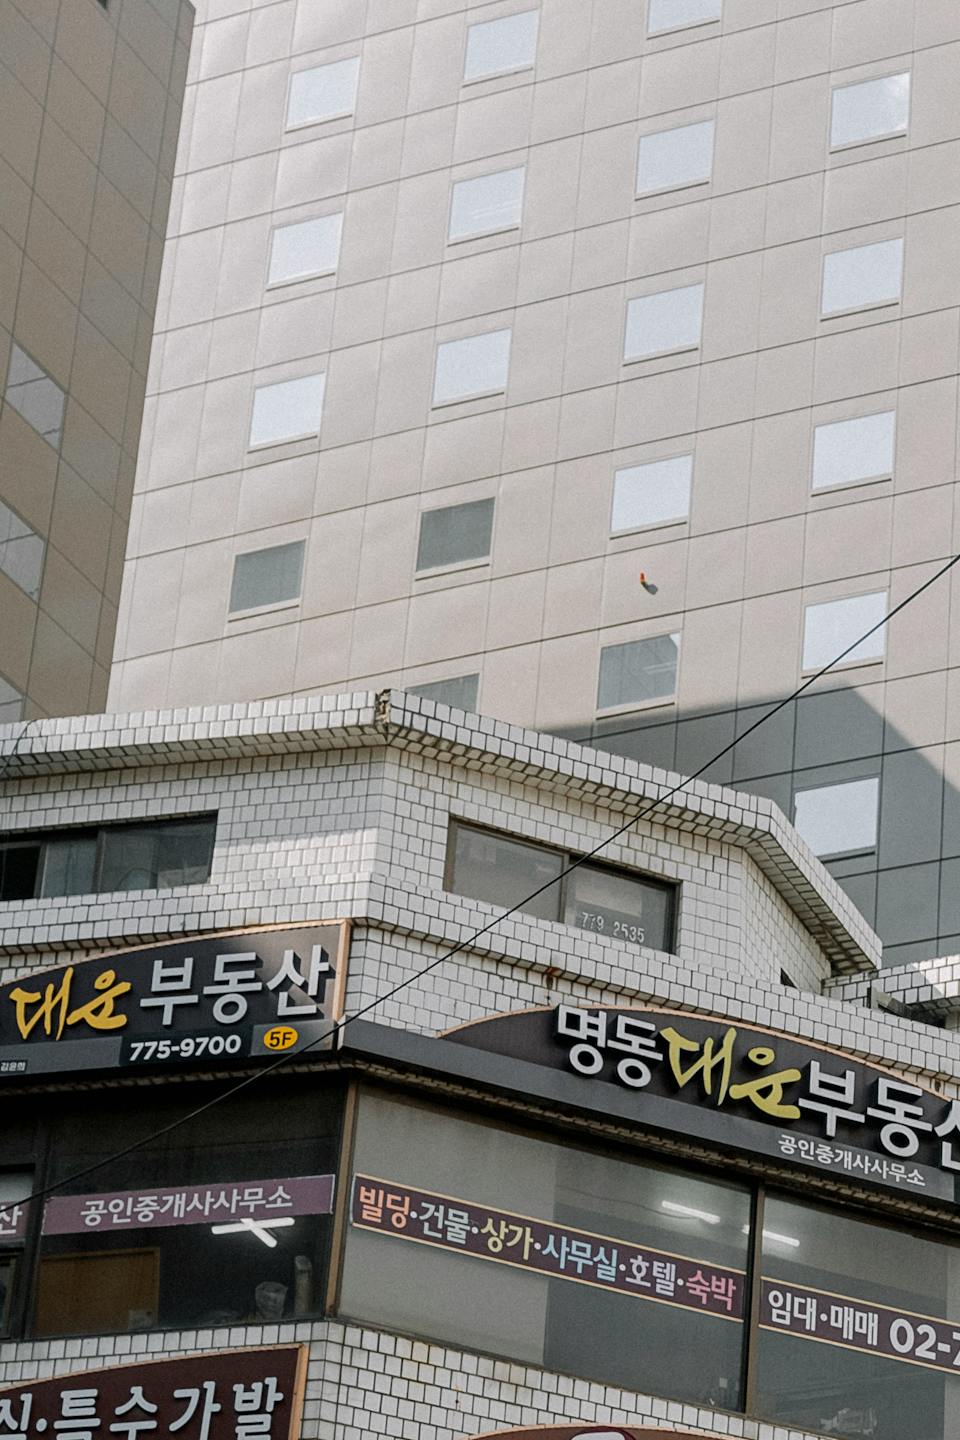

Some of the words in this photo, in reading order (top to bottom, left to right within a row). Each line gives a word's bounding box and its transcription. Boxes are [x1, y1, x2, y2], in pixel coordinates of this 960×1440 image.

[140, 944, 330, 1026] 부동산
[129, 1034, 242, 1062] 775-9700
[268, 1029, 294, 1049] 5F
[778, 1134, 926, 1187] 공인중개사사무소
[80, 1185, 293, 1227] 공인중개사사무소
